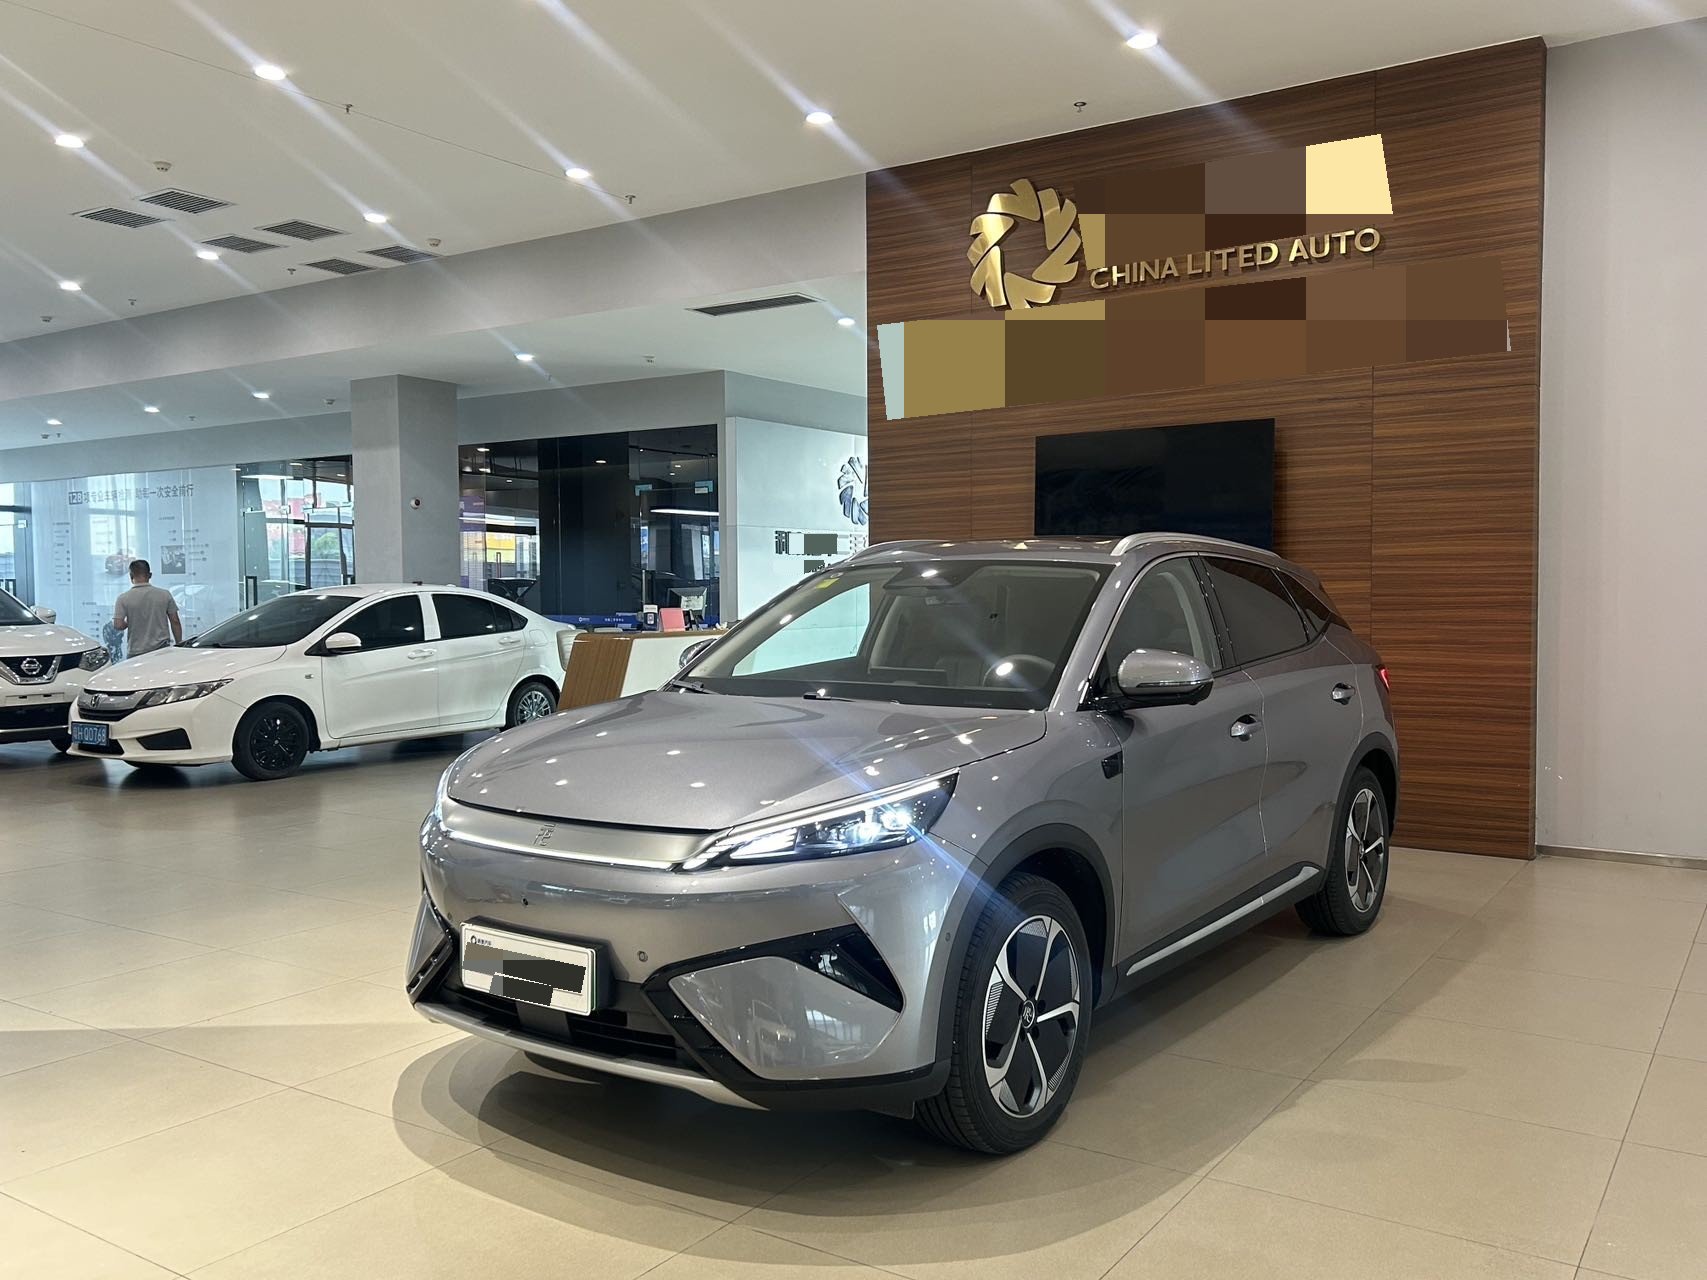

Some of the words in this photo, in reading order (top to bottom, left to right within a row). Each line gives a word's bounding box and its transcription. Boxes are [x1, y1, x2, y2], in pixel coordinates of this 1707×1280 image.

[1090, 257, 1179, 290] CHINA
[1187, 241, 1279, 275] LITED
[1288, 227, 1381, 262] AUTO
